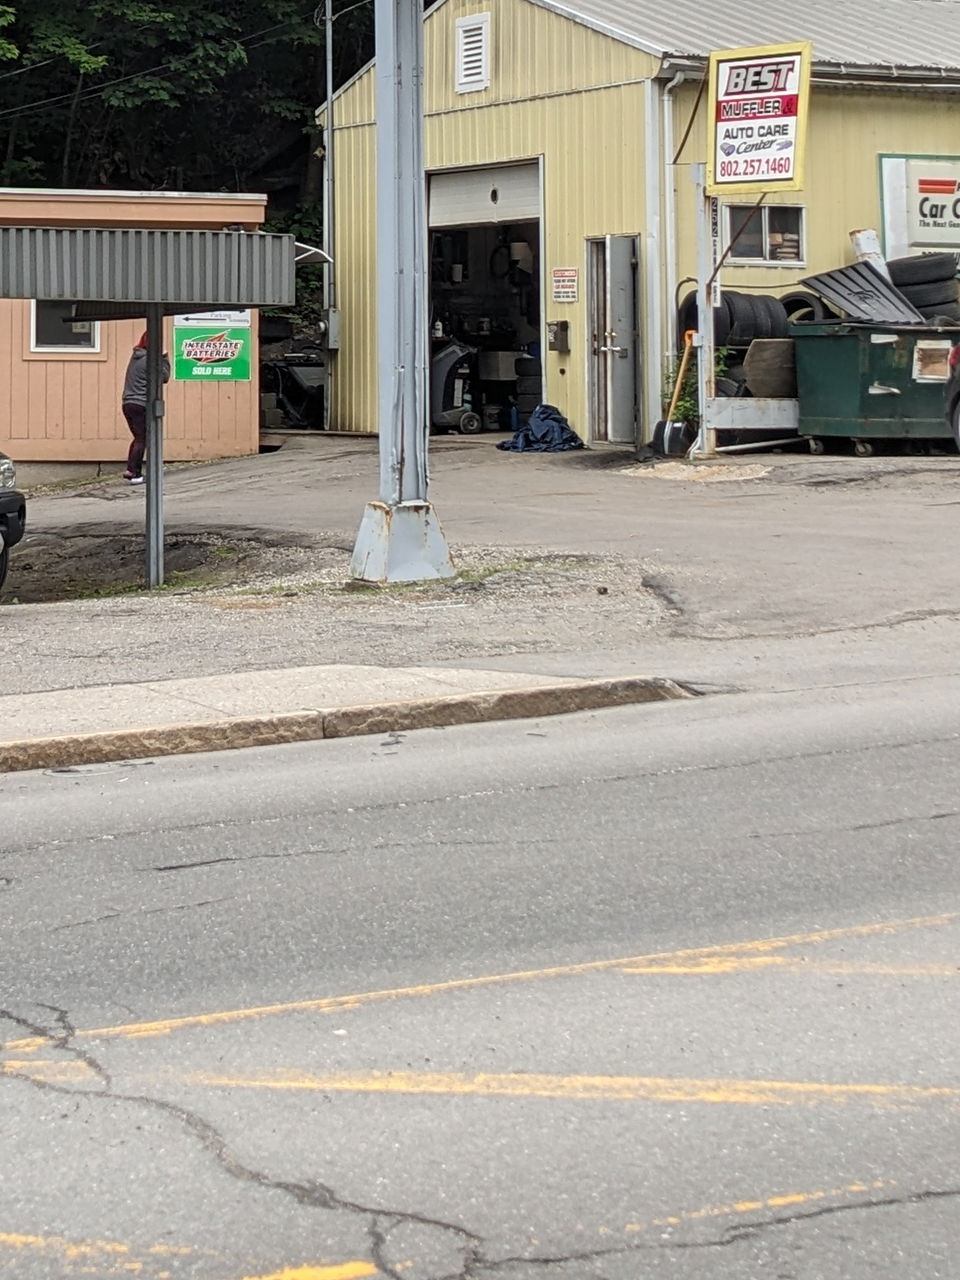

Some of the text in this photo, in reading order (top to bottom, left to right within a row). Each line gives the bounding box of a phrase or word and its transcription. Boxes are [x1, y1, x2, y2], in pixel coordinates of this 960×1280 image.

[724, 61, 795, 96] BEST
[721, 99, 781, 118] MUFFLER
[723, 124, 789, 140] AUTO CARE
[736, 138, 777, 155] Center
[720, 156, 791, 177] 802.257.1460
[919, 197, 947, 218] Car
[192, 367, 232, 375] SOLD HERE
